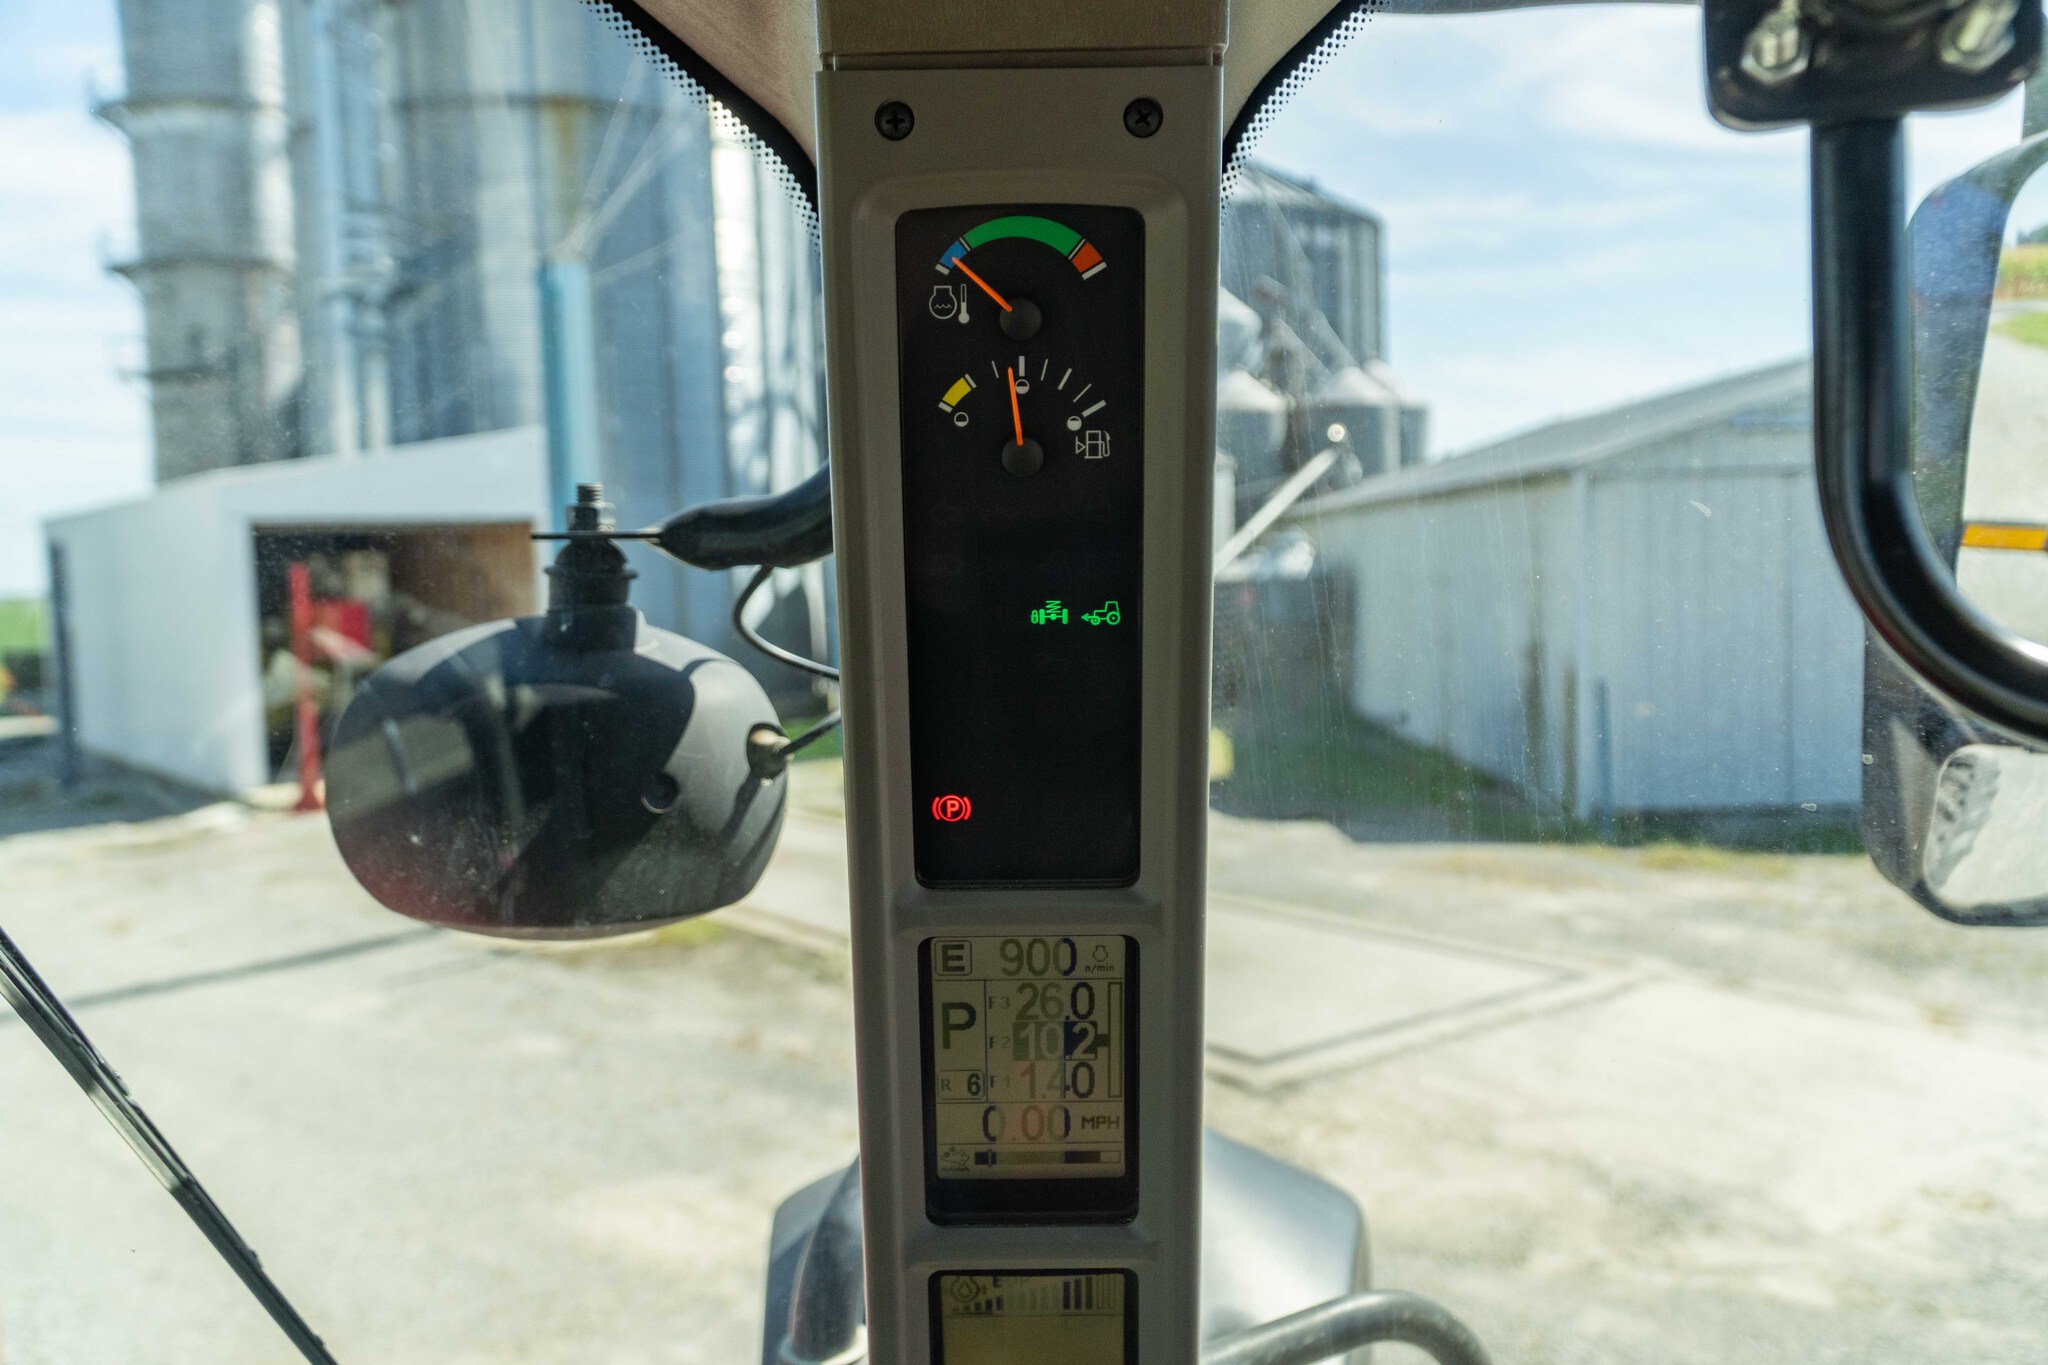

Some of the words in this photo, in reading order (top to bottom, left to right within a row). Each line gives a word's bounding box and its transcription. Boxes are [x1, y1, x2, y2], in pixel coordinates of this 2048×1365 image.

[941, 944, 966, 972] E
[999, 938, 1077, 976] 900
[1085, 962, 1115, 973] n/min
[1015, 982, 1095, 1021] 26.0
[941, 1002, 977, 1049] P
[967, 1073, 981, 1096] 6
[982, 1105, 1070, 1142] 0.00
[1081, 1116, 1120, 1130] MPH
